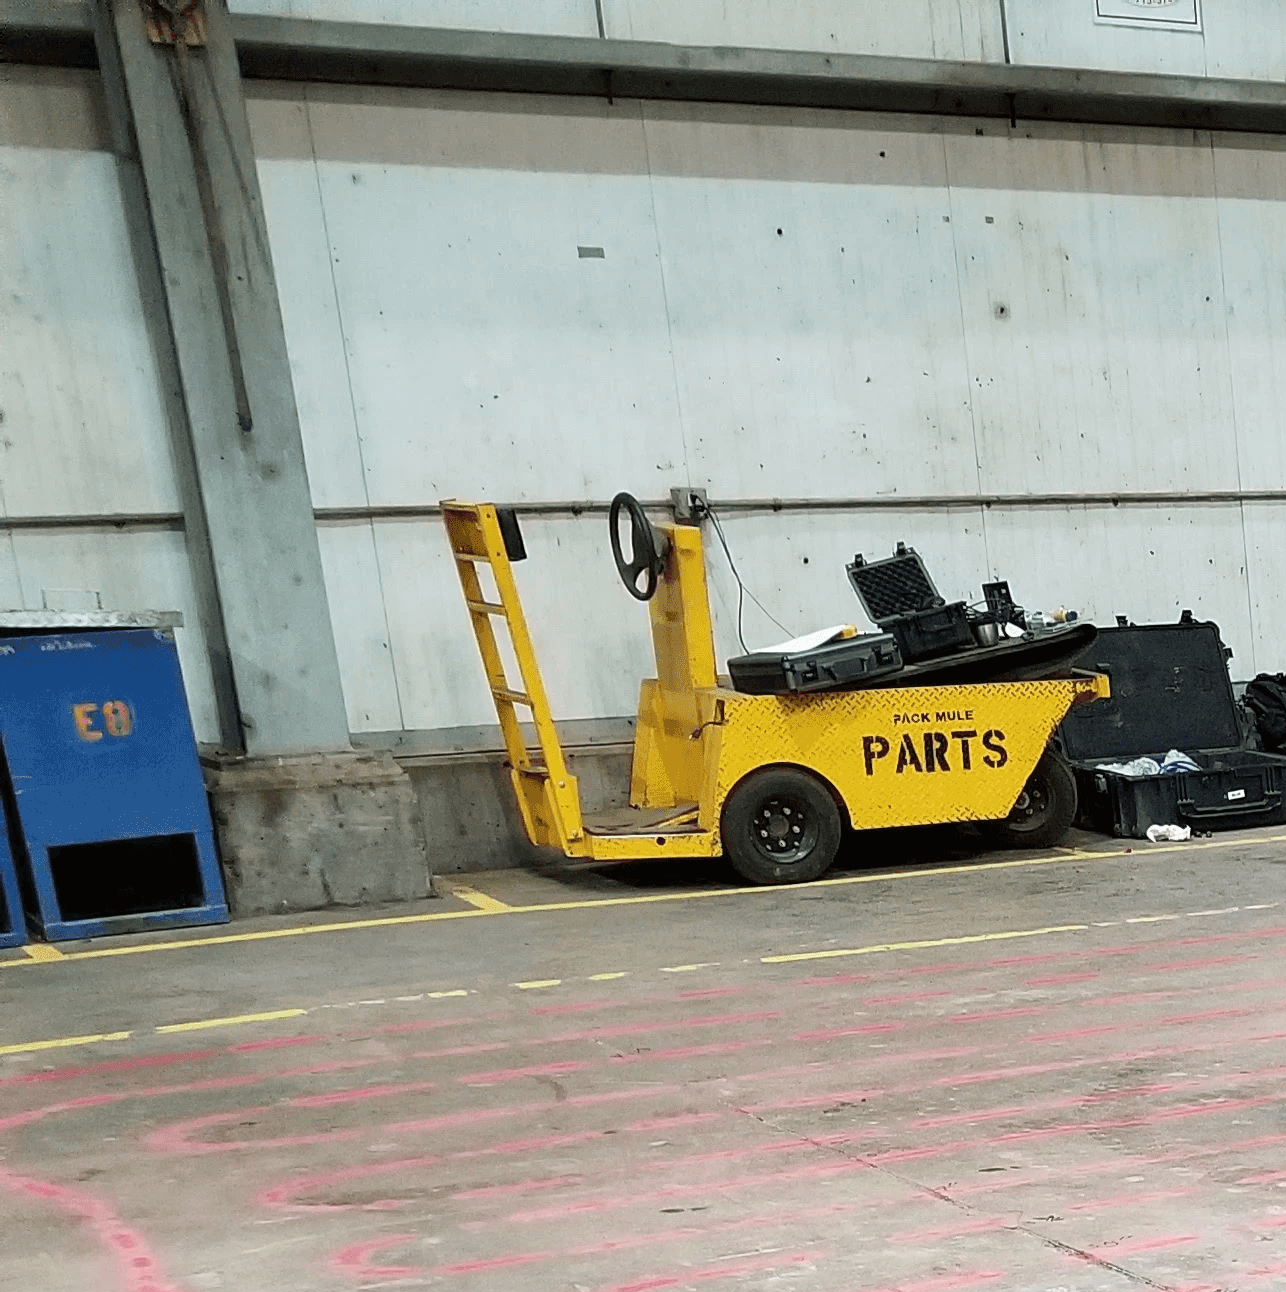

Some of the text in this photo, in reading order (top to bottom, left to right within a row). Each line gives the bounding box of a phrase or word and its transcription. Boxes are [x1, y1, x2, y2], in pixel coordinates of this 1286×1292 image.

[893, 709, 975, 727] PACK MULE
[861, 728, 1008, 777] PARTS
